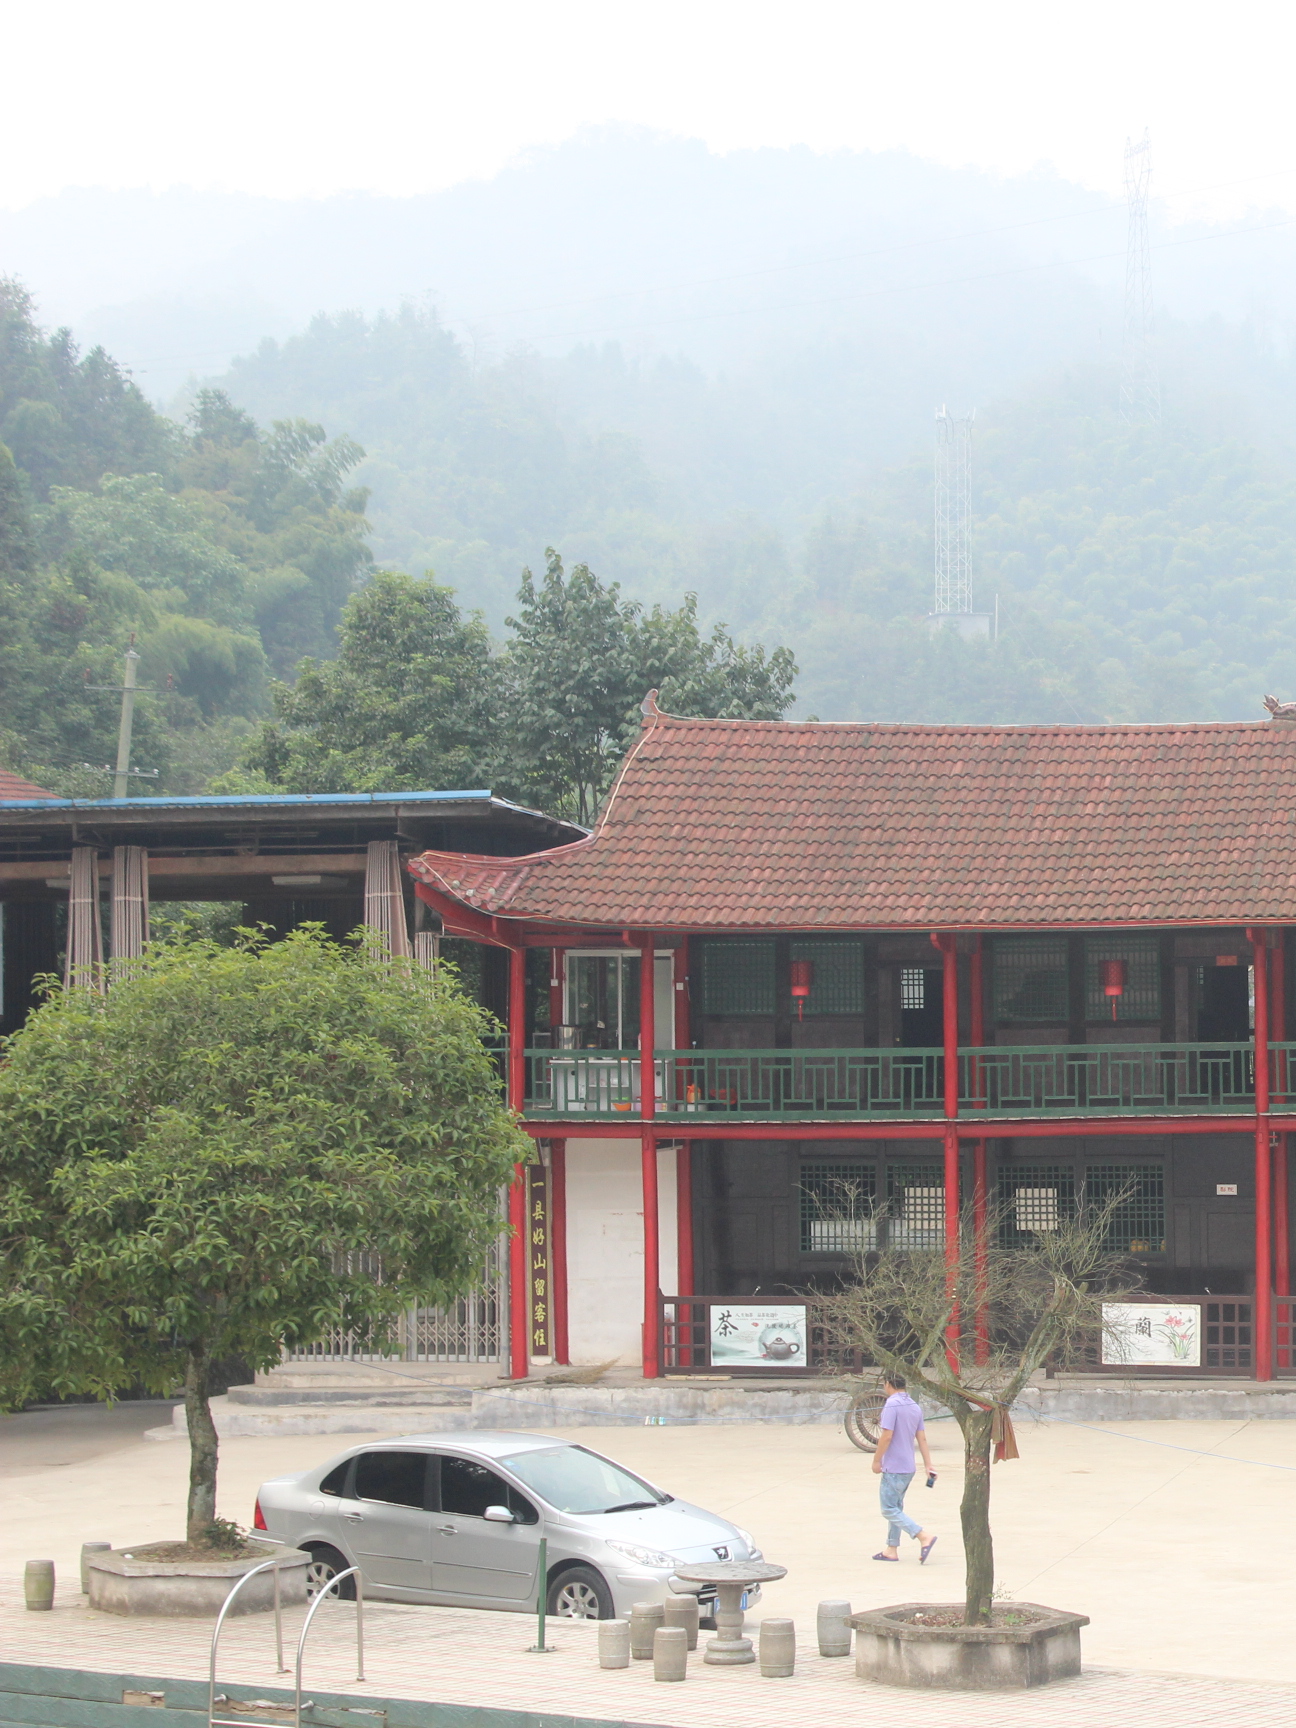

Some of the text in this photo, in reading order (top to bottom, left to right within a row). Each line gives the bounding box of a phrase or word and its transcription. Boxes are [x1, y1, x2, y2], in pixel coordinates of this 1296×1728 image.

[531, 1181, 547, 1347] 一县好山留客住
[714, 1309, 739, 1337] 茶
